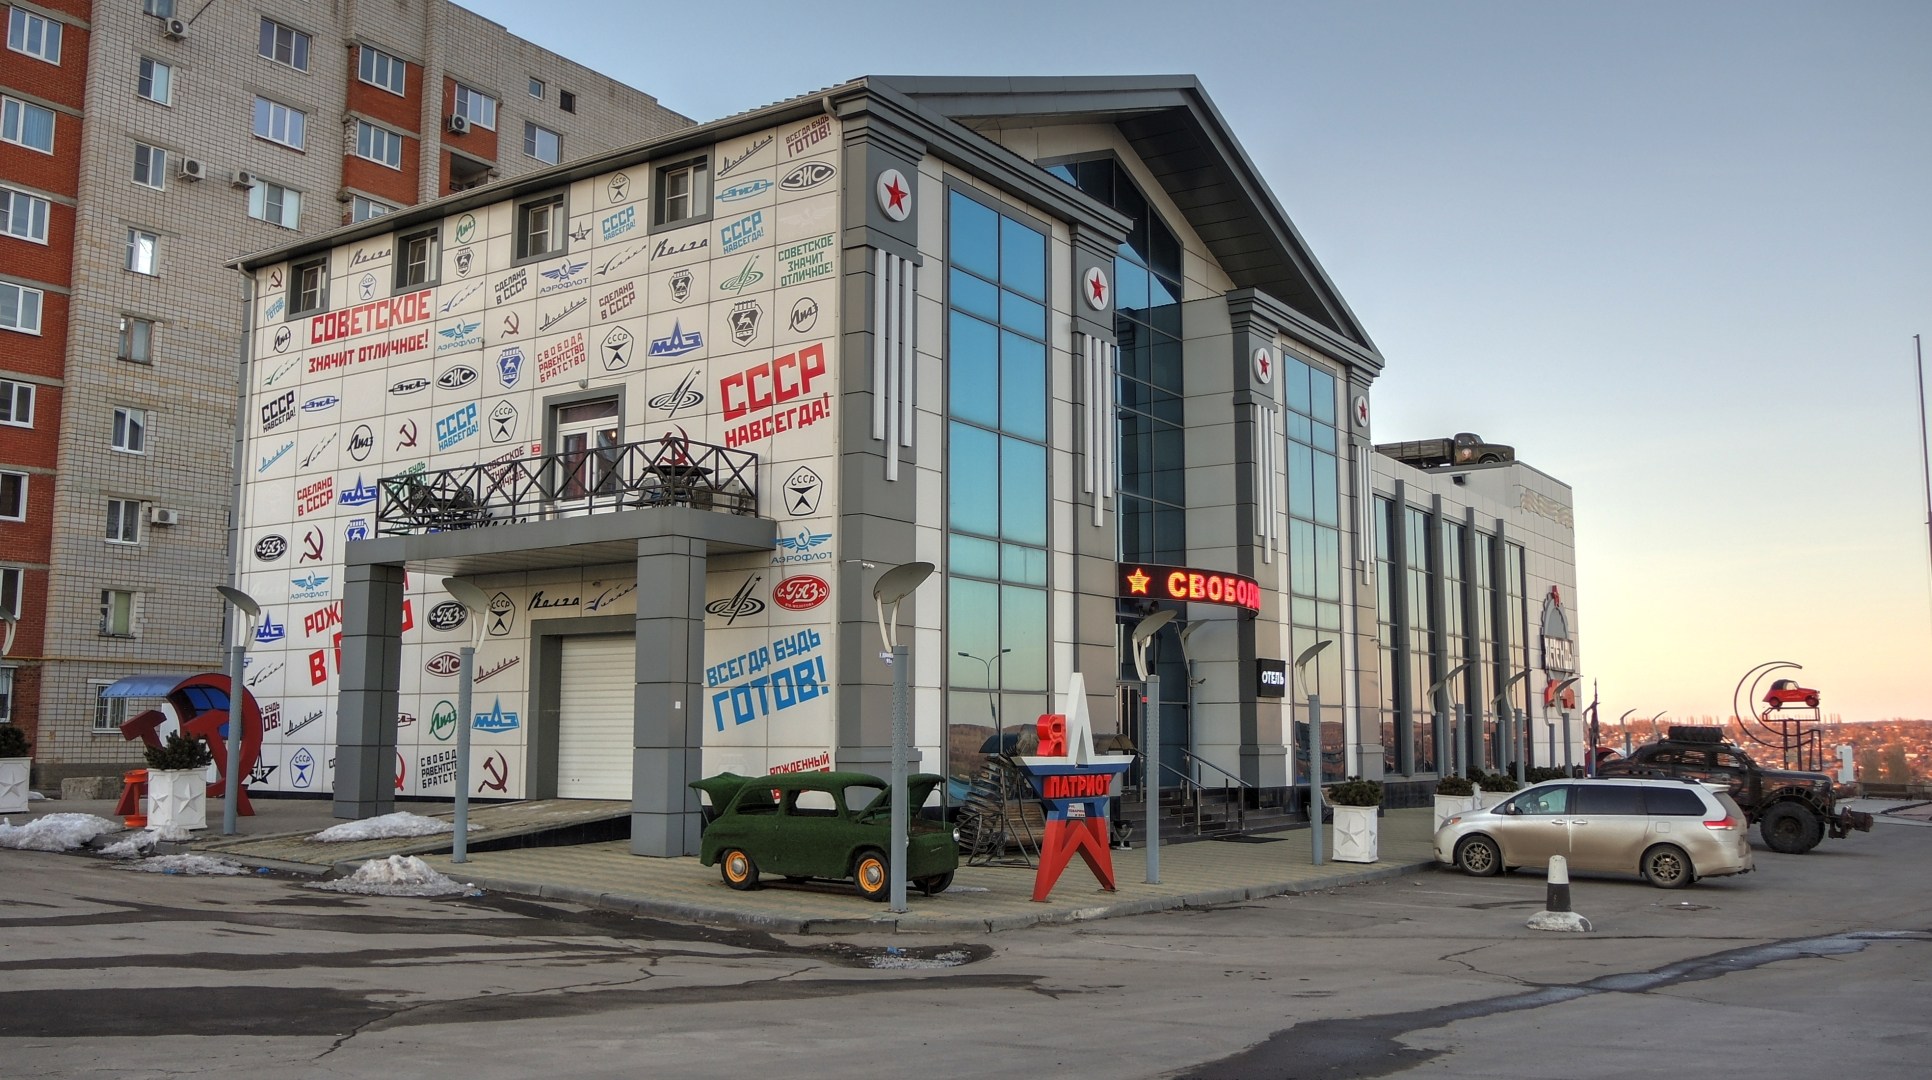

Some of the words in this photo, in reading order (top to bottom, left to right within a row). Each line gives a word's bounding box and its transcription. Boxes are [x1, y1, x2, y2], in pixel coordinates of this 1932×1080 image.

[785, 126, 811, 145] ВСЕГДА
[811, 114, 830, 129] БУДЬ
[787, 122, 832, 158] ГОТОВ!
[781, 165, 832, 189] ЗИС
[602, 205, 635, 234] СССР
[603, 219, 636, 241] НАВСЕГДА!
[720, 210, 763, 246] СССР
[723, 227, 764, 255] НАВСЕГДА!
[778, 235, 833, 262] СОВЕТСКОЕ
[780, 261, 834, 287] ОТЛИЧНОЕ!
[787, 251, 824, 273] ЗНАЧИТ
[494, 268, 526, 293] СДЕЛАНО
[496, 295, 502, 305] В
[503, 277, 528, 301] СССР
[540, 277, 589, 294] АЭРОФЛОТ
[599, 281, 634, 307] СДЕЛАНО
[600, 309, 607, 320] В
[609, 291, 636, 316] СССР
[310, 290, 431, 344] СОВЕТСКОЕ
[309, 348, 355, 373] ЗНАЧИТ
[358, 328, 429, 362] ОТЛИЧНОЕ!
[437, 337, 483, 352] АЭРОФЛОТ
[537, 332, 583, 363] СВОБОДА
[607, 333, 628, 345] СССР
[438, 368, 476, 387] ЗИС
[540, 353, 586, 383] БРАТСТВО
[720, 342, 826, 422] СССР
[262, 390, 295, 424] СССР
[263, 407, 296, 433] НАВСЕГДА!
[494, 407, 512, 418] СССР
[435, 402, 477, 442] СССР
[724, 392, 830, 449] НАВСЕГДА!
[438, 421, 479, 452] НАВСЕГДА!
[296, 476, 333, 501] СДЕЛАНО
[791, 474, 815, 487] СССР
[297, 505, 304, 517] В
[306, 489, 333, 514] СССР
[771, 551, 832, 564] АЭРОФЛОТ
[290, 590, 330, 600] АЭРОФЛОТ
[786, 579, 819, 603] ГАЗ
[309, 649, 327, 686] В
[706, 645, 771, 688] ВСЕГДА
[773, 628, 821, 662] БУДЬ
[1261, 671, 1285, 686] ОТЕЛЬ
[712, 655, 829, 732] ГОТОВ!
[473, 693, 518, 728] МАЗ
[420, 749, 457, 767] СВОБОД
[421, 760, 457, 778] РАВЕНТСТ
[422, 771, 457, 789] БРАТСТ
[1044, 774, 1112, 798] ПАТРИОТ
